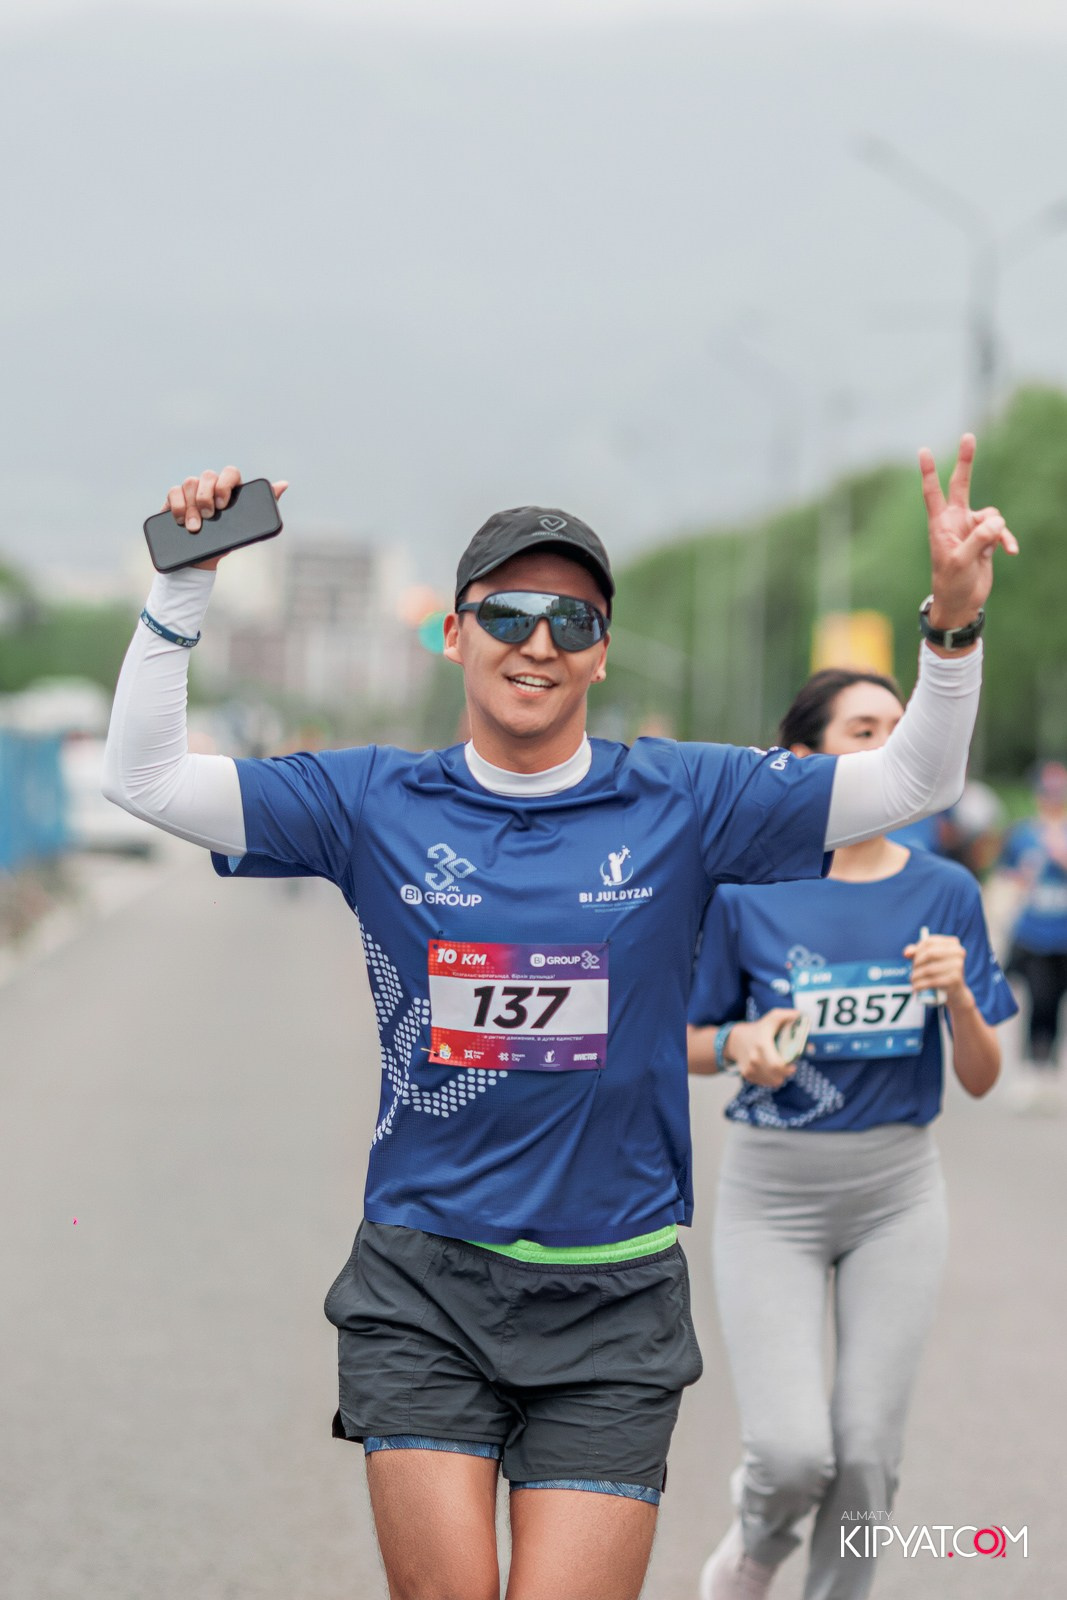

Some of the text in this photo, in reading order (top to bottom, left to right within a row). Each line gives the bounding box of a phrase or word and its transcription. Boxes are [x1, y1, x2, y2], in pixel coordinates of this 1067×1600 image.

[403, 886, 482, 907] BI GROUP
[579, 886, 653, 903] BI JULDYZAI
[437, 949, 487, 966] 10 KM
[547, 955, 581, 965] GROUP
[474, 985, 572, 1029] 137
[816, 993, 912, 1029] 1857
